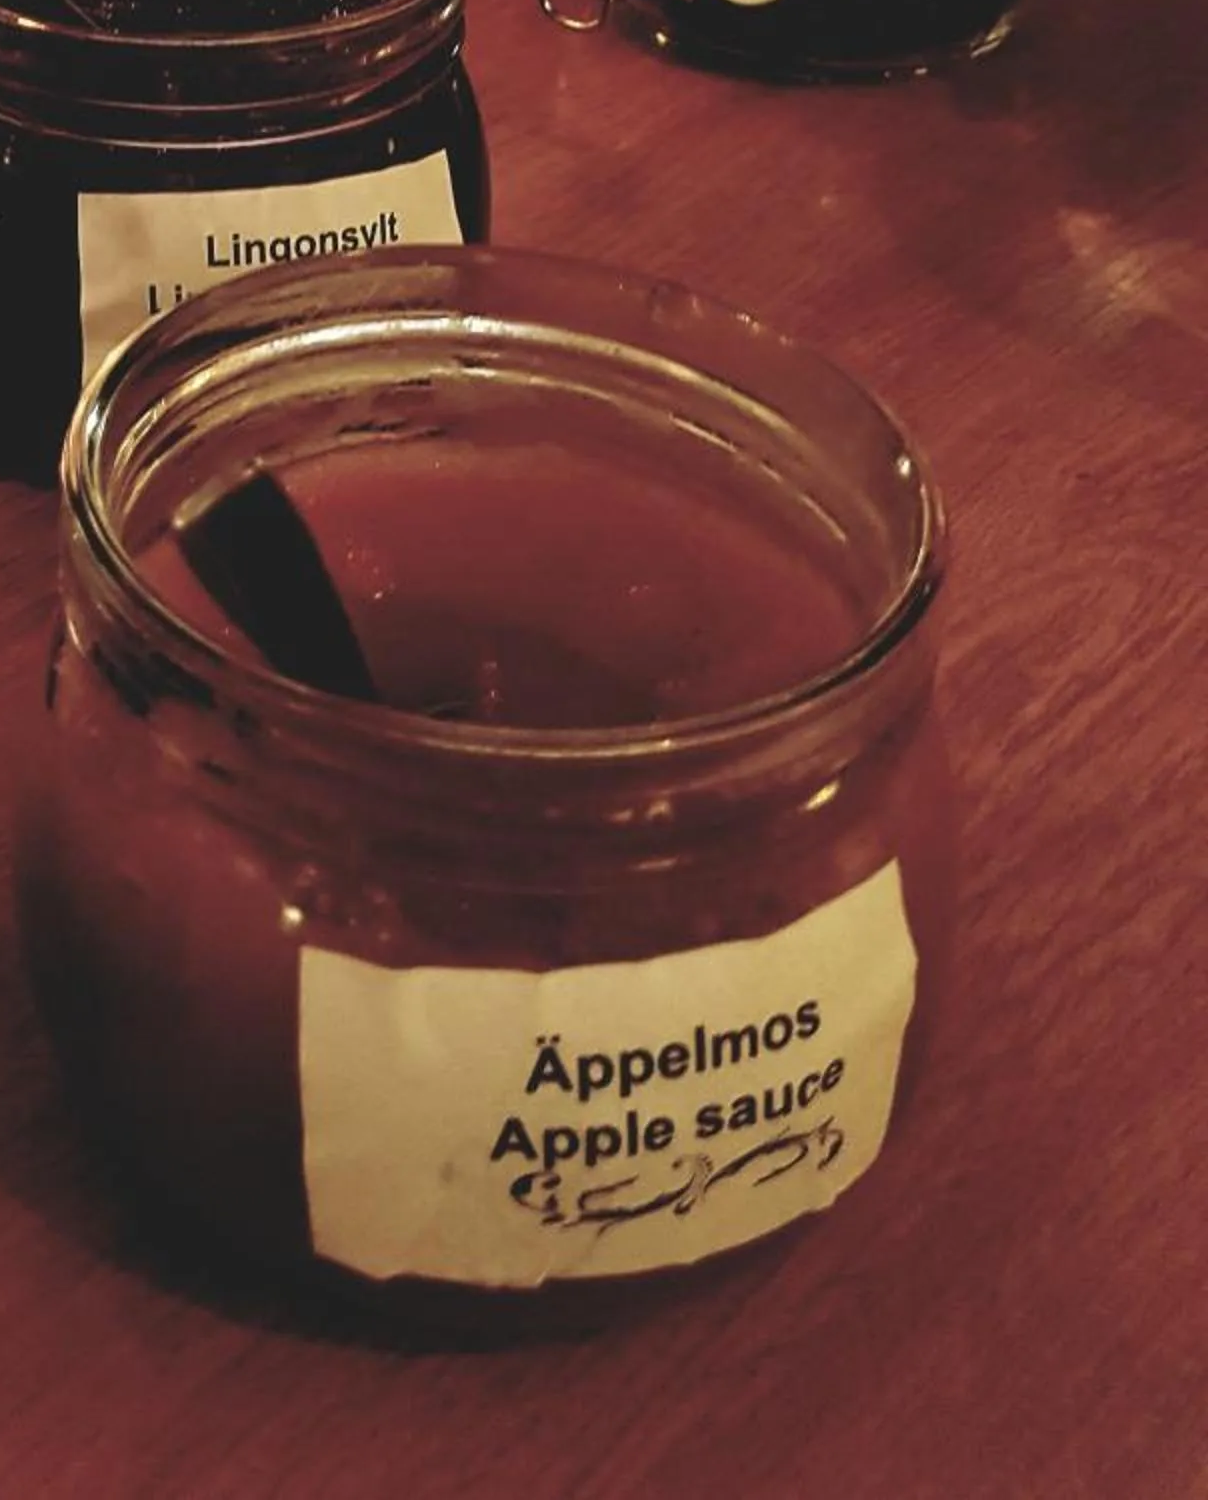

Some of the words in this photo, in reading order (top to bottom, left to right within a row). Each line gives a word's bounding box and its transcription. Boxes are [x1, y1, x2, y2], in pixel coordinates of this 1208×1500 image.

[206, 212, 399, 267] Lingonsylt
[525, 1000, 822, 1102] Äppelmos
[490, 1110, 675, 1172] Apple
[695, 1056, 846, 1140] sauce
